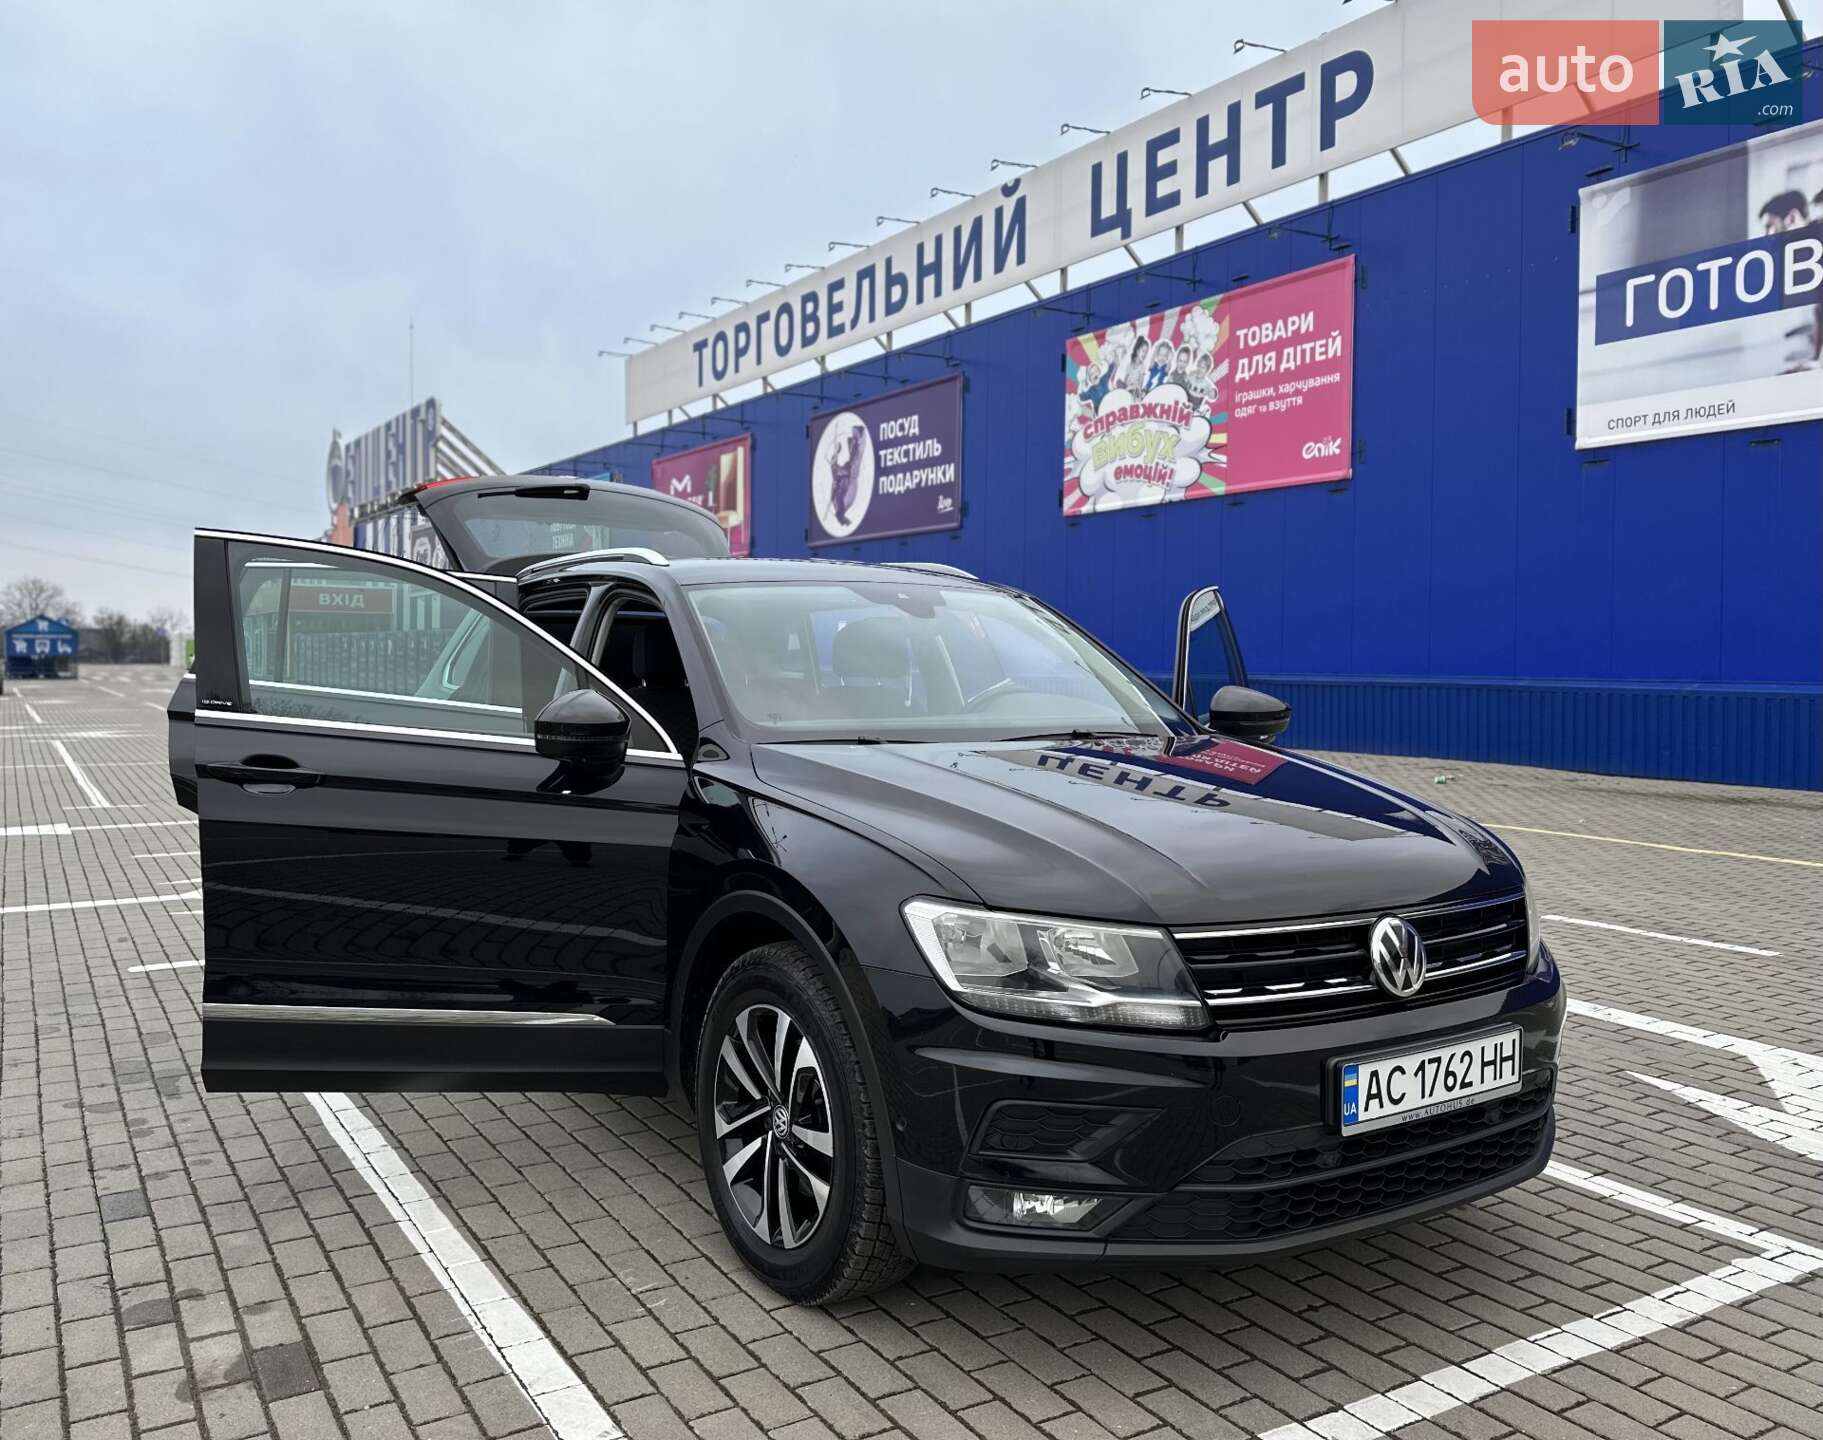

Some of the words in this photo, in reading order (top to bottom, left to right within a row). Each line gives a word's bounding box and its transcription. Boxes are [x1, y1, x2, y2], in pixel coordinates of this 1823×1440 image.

[693, 177, 1027, 388] ТОРГОВЕЛЬНИЙ
[1091, 50, 1375, 240] ЦЕНТР
[1625, 238, 1823, 327] ГОТОВ
[1235, 311, 1314, 350] ТОВАРИ
[1234, 351, 1277, 384] ДЛЯ
[1280, 330, 1342, 373] ДІТЕЙ
[1235, 386, 1276, 403] іграшки,
[1278, 372, 1341, 393] харчування
[1083, 401, 1193, 438] справжній
[1235, 404, 1257, 418] одяг
[1268, 396, 1303, 412] взуття
[1607, 414, 1648, 430] СПОРТ
[1652, 408, 1680, 426] ДЛЯ
[1684, 400, 1736, 420] ЛЮДЕЙ
[880, 414, 920, 441] ПОСУД
[879, 438, 942, 468] ТЕКСТИЛЬ
[879, 462, 955, 495] ПОДАРУНКИ
[318, 592, 366, 609] ВХІД
[1364, 1065, 1407, 1113] AC
[1413, 1049, 1474, 1100] 1762
[1480, 1038, 1517, 1085] HH
[1343, 1103, 1358, 1116] UA
